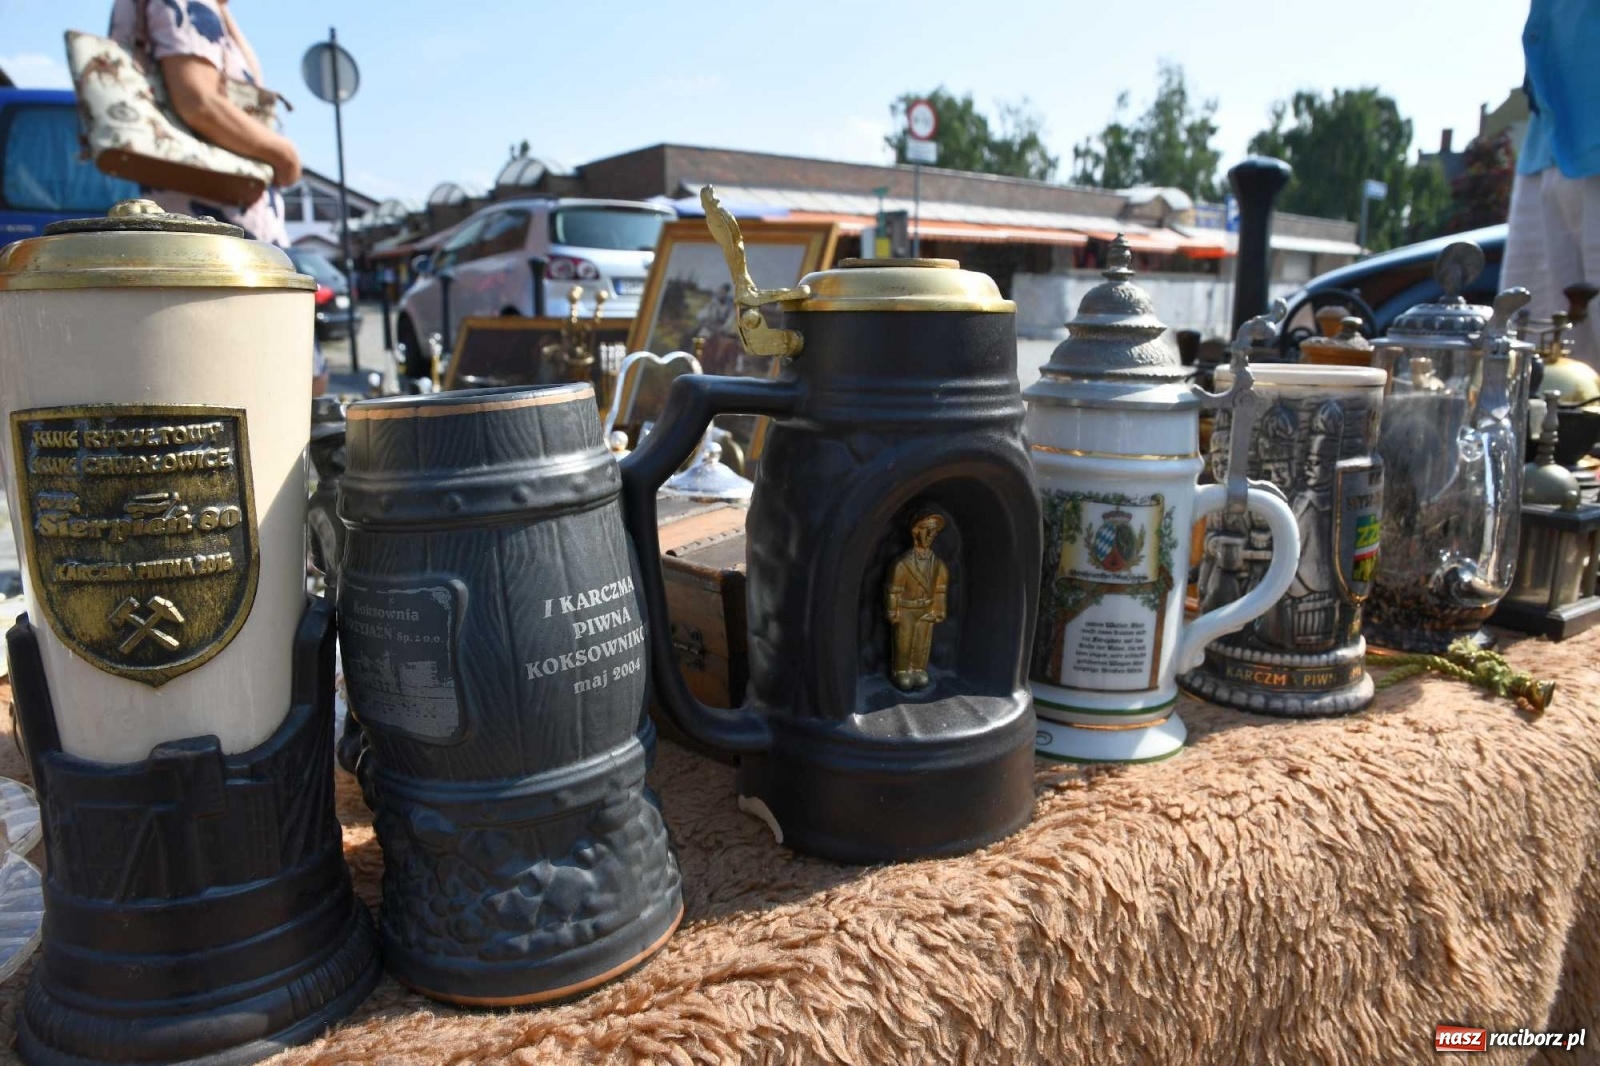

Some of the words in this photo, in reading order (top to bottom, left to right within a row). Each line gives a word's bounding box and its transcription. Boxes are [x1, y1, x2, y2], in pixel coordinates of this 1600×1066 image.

[197, 505, 242, 531] 80
[353, 600, 420, 621] Koksownia
[543, 598, 555, 619] I
[559, 575, 635, 614] KARCZMA
[396, 631, 413, 644] Sp.
[572, 606, 632, 640] PIWNA
[573, 669, 609, 695] maj
[612, 657, 641, 681] 2004
